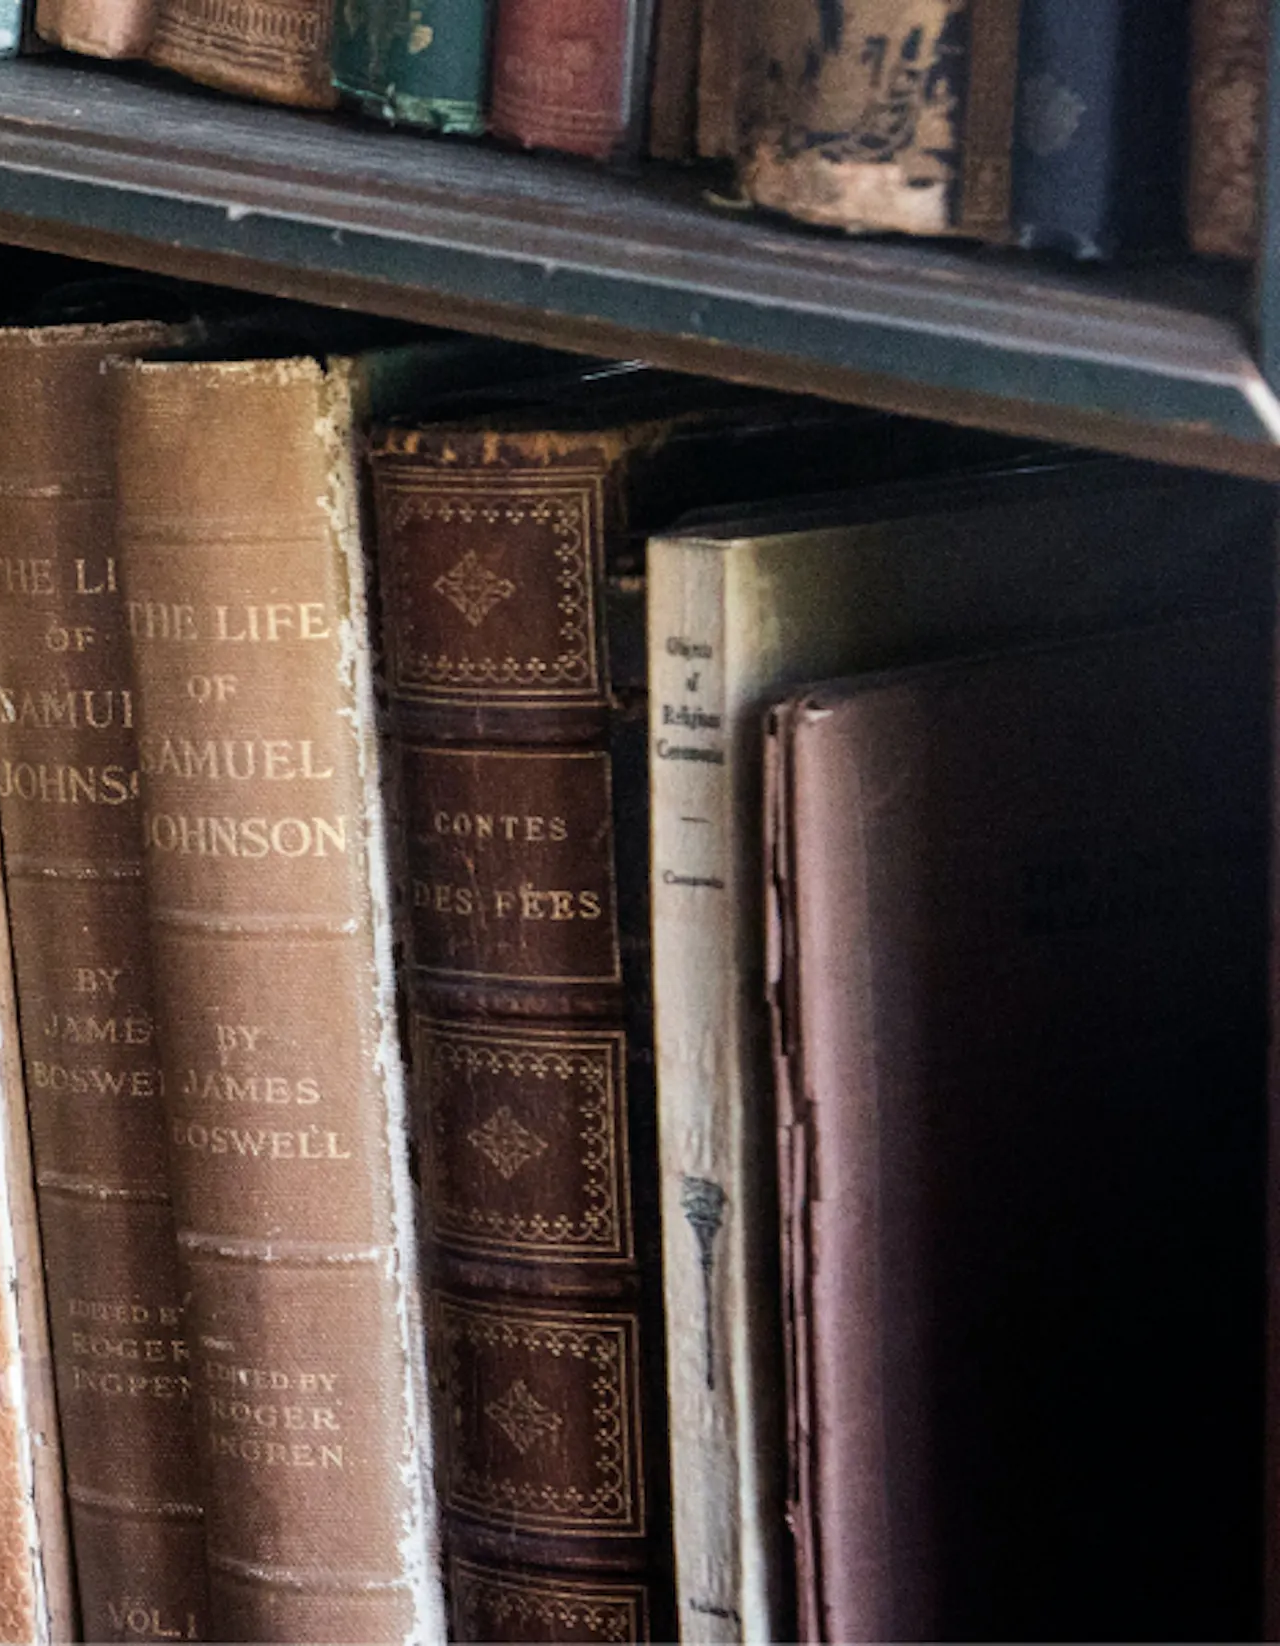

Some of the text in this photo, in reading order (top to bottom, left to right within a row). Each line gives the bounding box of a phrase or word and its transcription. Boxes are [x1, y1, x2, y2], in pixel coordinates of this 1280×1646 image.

[74, 558, 119, 595] LI
[45, 625, 96, 653] OF
[125, 601, 333, 642] THE LIFE
[187, 673, 239, 702] OF
[0, 688, 134, 730] SAMU
[137, 738, 335, 782] SAMUEL
[0, 760, 142, 806] JOHNS
[434, 810, 569, 842] CONTES
[413, 879, 603, 922] DES FÉES
[73, 967, 122, 994] BY
[44, 1012, 153, 1045] JAME
[215, 1022, 263, 1052] BY
[32, 1060, 166, 1097] BOSWE
[183, 1069, 322, 1105] JAMES
[298, 1372, 339, 1393] BY
[209, 1397, 341, 1431] ROGER
